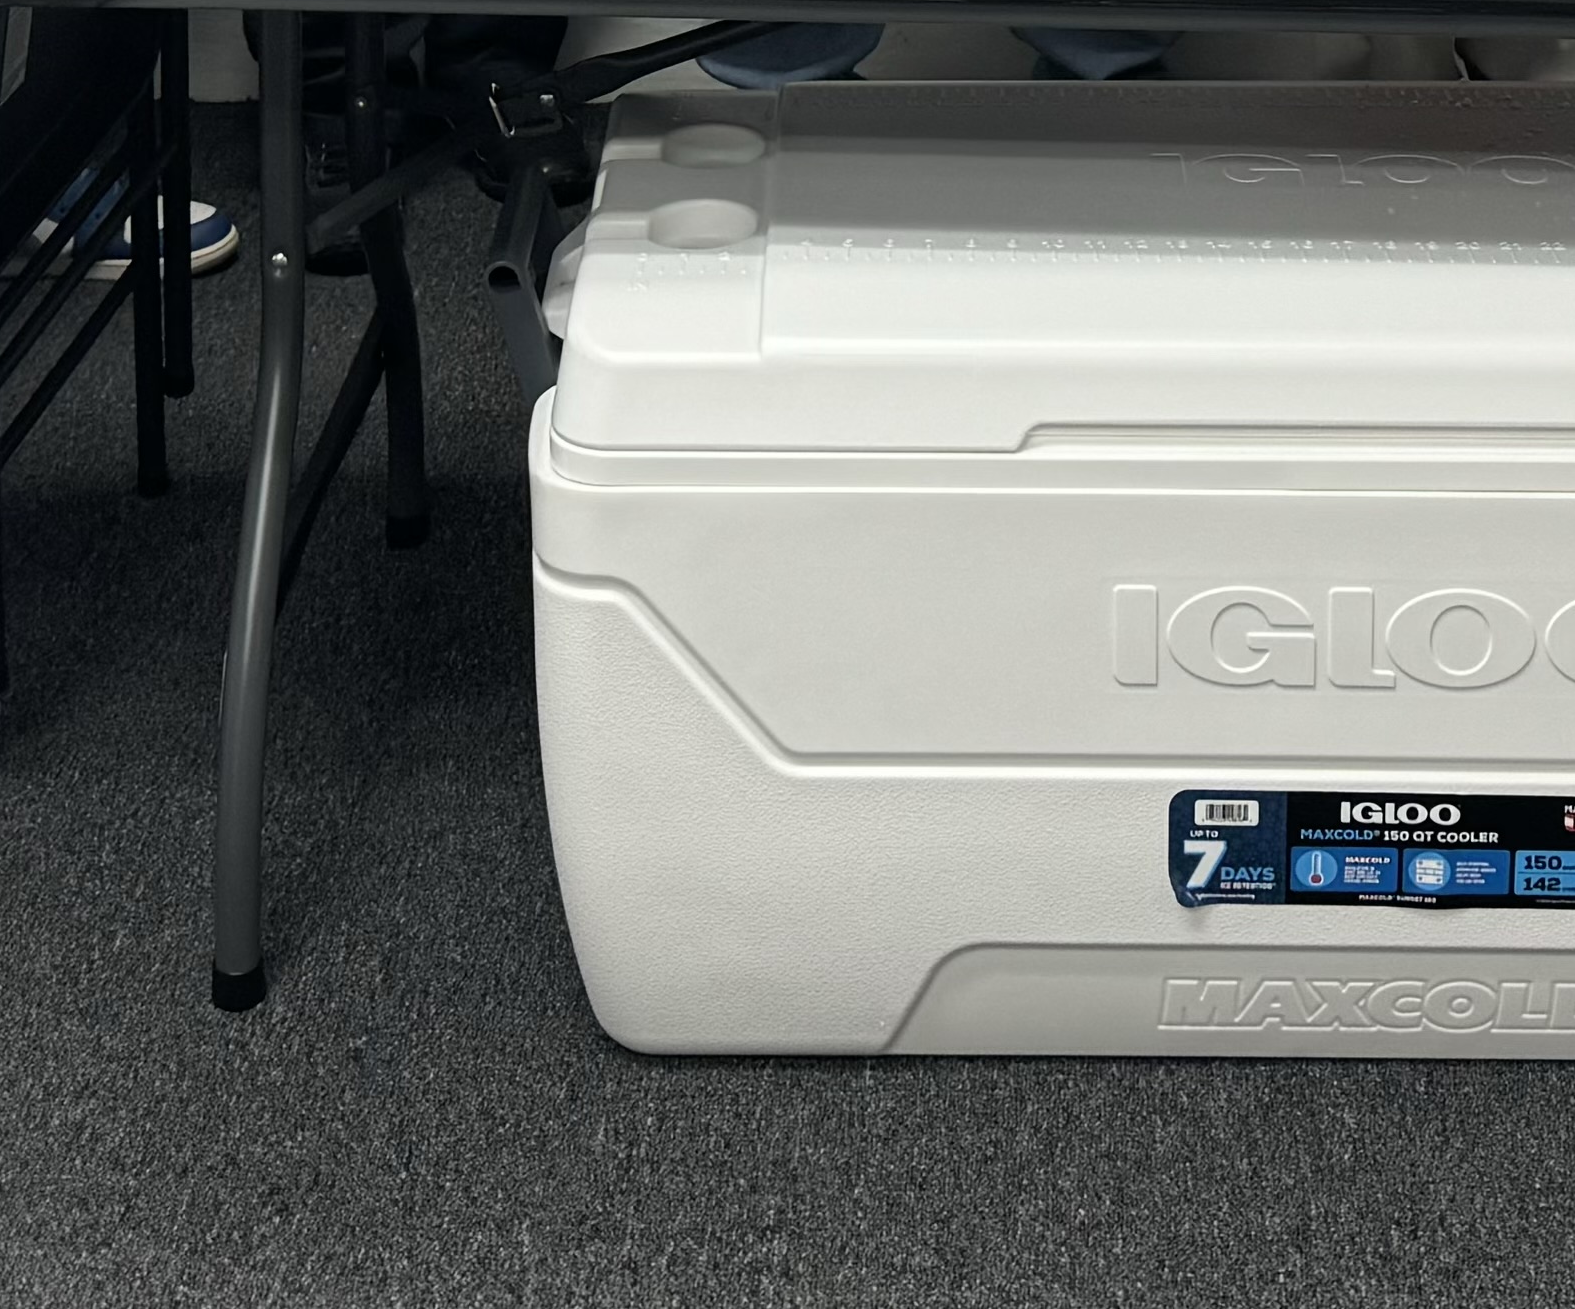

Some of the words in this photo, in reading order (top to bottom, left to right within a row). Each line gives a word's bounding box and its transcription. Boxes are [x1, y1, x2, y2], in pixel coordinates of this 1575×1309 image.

[1340, 801, 1461, 826] IGLOO
[1190, 830, 1203, 838] UP
[1205, 830, 1219, 838] TO
[1383, 830, 1409, 842] 150
[1412, 831, 1434, 843] QT
[1437, 831, 1499, 844] COOLER
[1183, 839, 1228, 890] 7
[1524, 855, 1562, 870] 150
[1220, 867, 1275, 881] DAYS
[1523, 877, 1561, 891] 142
